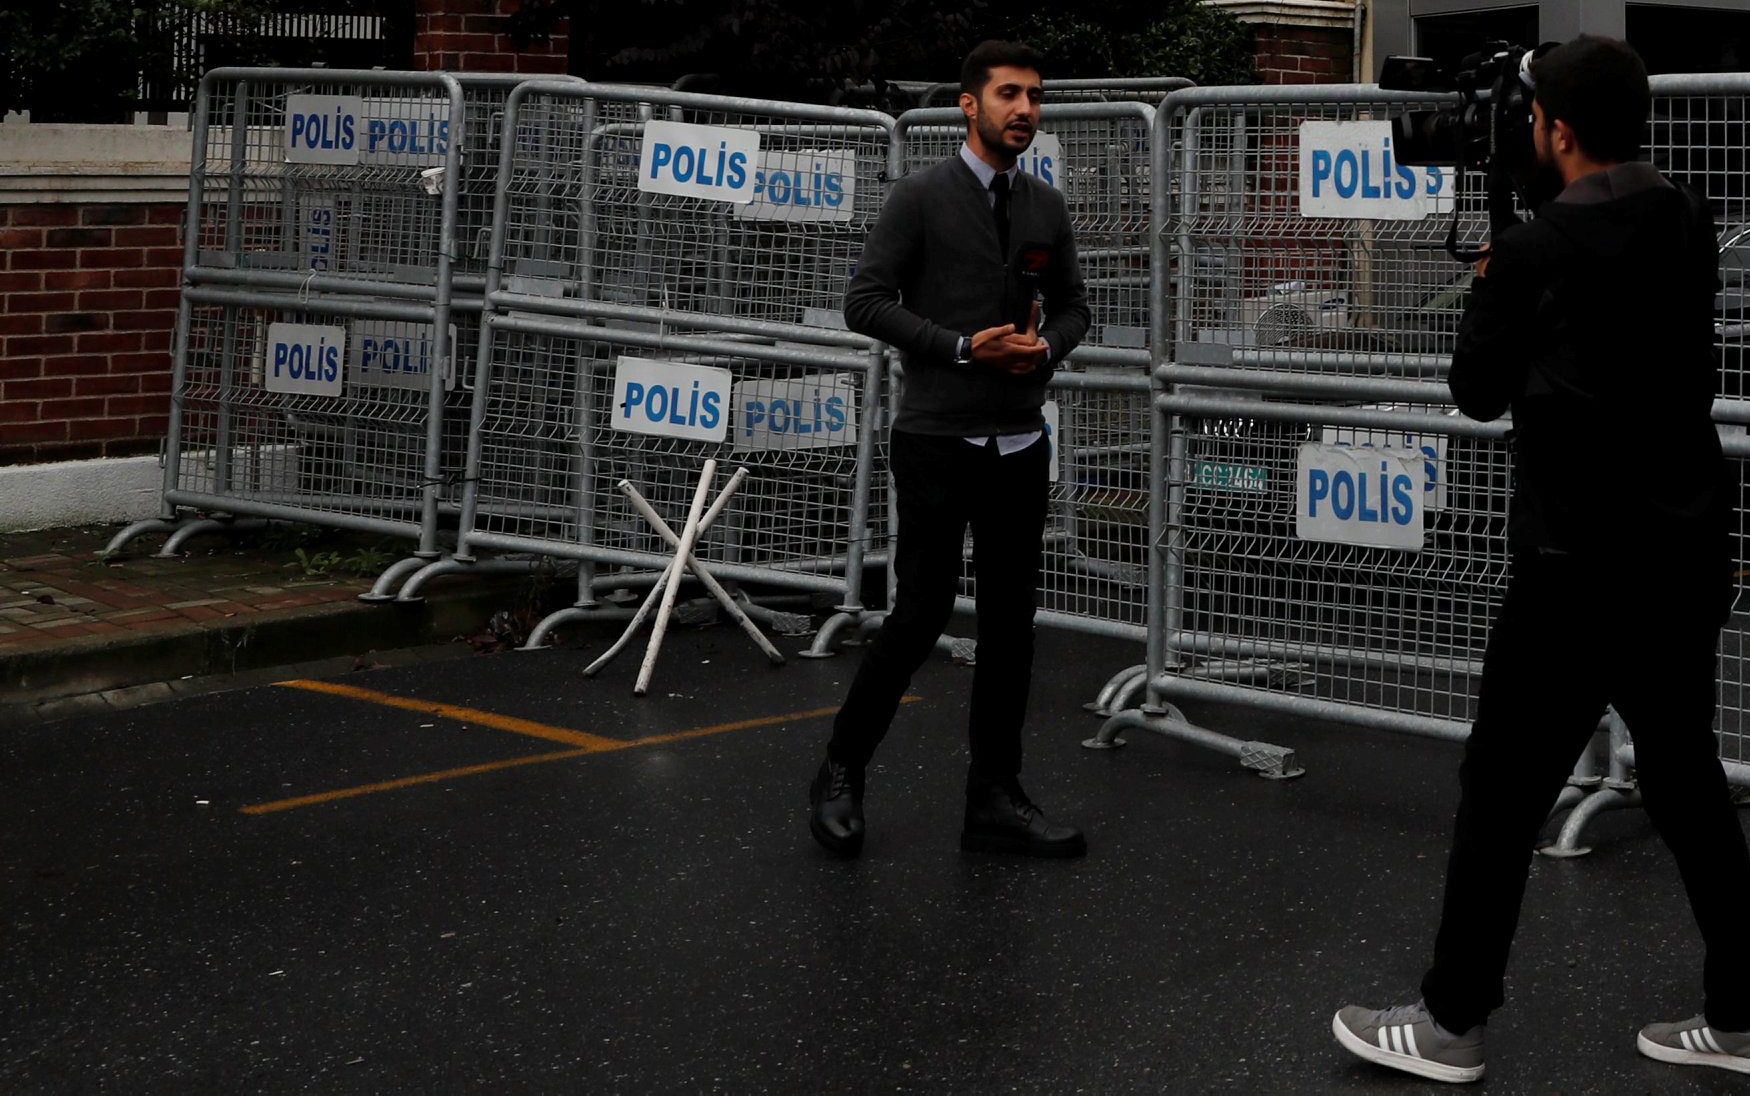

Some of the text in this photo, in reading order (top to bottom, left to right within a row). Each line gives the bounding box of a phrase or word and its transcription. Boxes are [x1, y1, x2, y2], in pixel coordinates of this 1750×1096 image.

[291, 106, 354, 151] POLİS
[650, 141, 748, 190] POLİS
[1312, 137, 1417, 200] POLİS
[274, 337, 339, 382] POLİS
[361, 332, 433, 374] POLİ
[623, 380, 721, 430] POLİS
[745, 388, 846, 437] POLİS
[1308, 460, 1414, 526] POLİS
